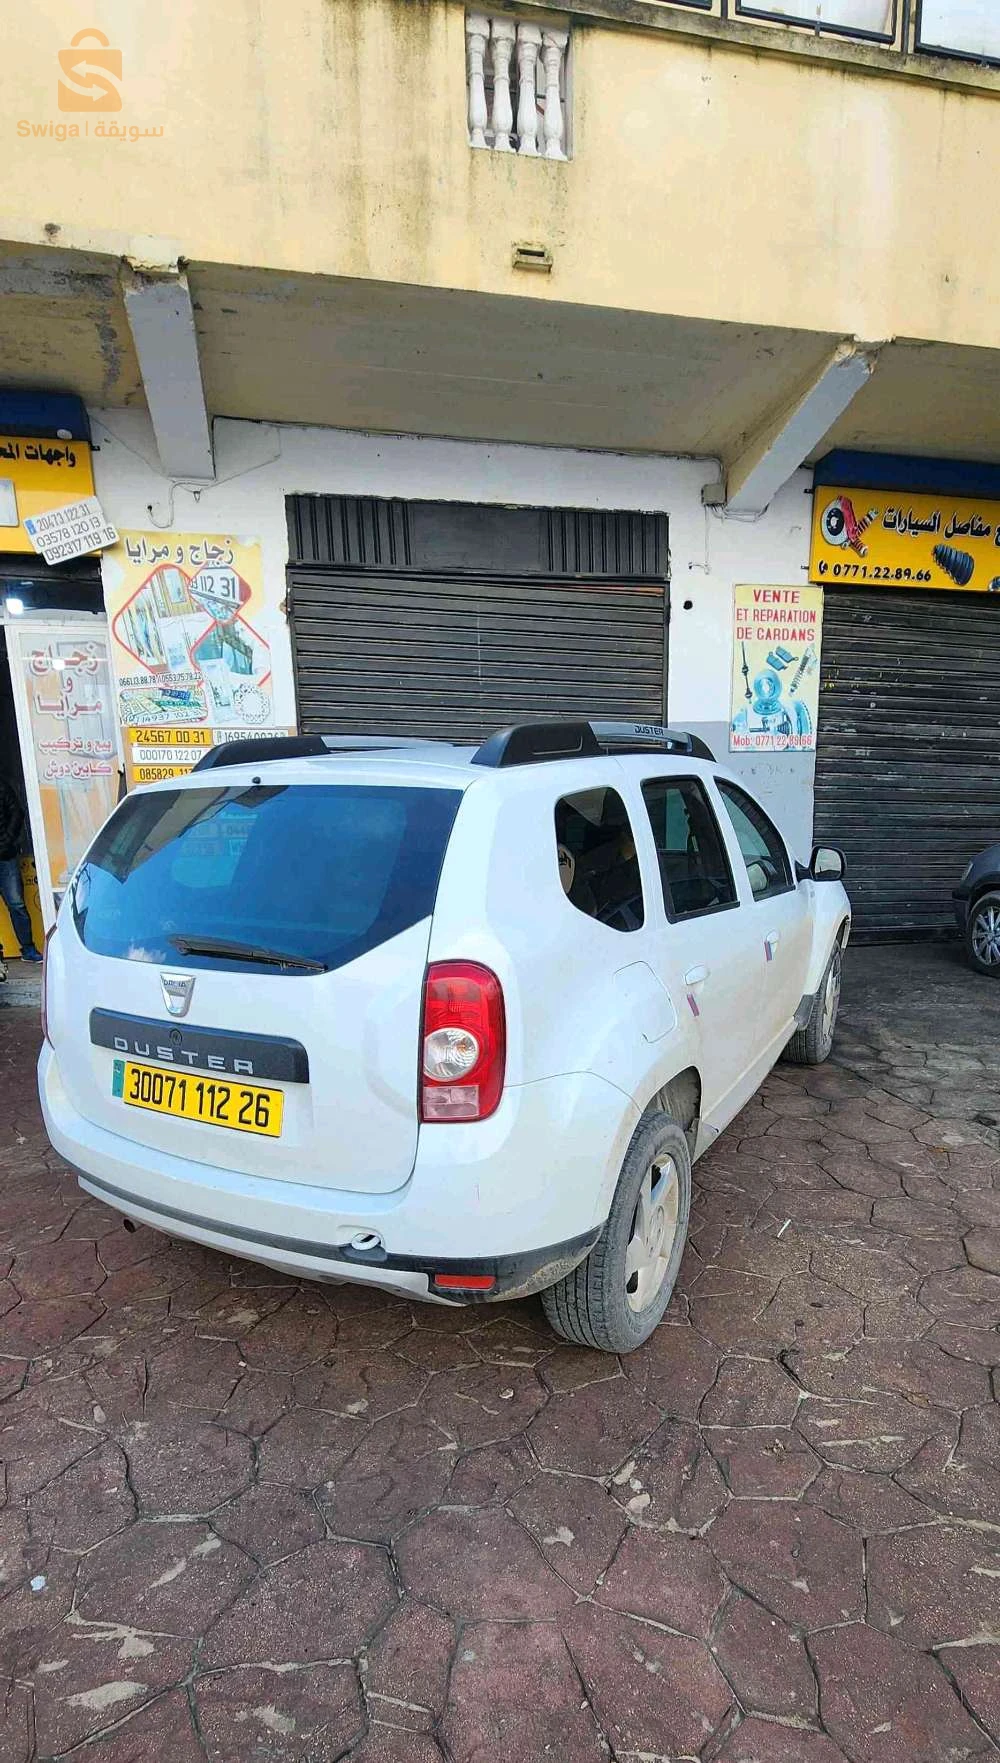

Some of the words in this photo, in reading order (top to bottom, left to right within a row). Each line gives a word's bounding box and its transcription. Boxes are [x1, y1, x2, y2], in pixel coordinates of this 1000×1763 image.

[24, 443, 76, 467] واجهات
[36, 512, 65, 531] 20473
[63, 506, 79, 521] 122
[79, 503, 92, 515] 31
[882, 506, 941, 536] السيارات
[944, 511, 990, 538] مفاصل
[36, 528, 71, 547] 03578
[71, 520, 90, 534] 120
[89, 516, 101, 529] 13
[44, 539, 82, 561] 092317
[83, 531, 102, 548] 119
[102, 527, 116, 541] 16
[126, 537, 169, 563] مرايا
[176, 546, 184, 563] و
[189, 539, 234, 565] زجاج
[833, 563, 932, 582] 0771.22.89.66
[200, 575, 215, 593] 112
[219, 577, 236, 599] 31
[752, 589, 801, 604] VENTE
[736, 608, 749, 621] ET
[752, 609, 817, 623] REPARATION
[736, 627, 753, 641] DE
[756, 627, 816, 642] CARDANS
[31, 645, 98, 673] زجاج
[37, 694, 103, 717] مرايا
[136, 730, 172, 744] 24567
[176, 731, 191, 744] 00
[193, 731, 206, 744] 31
[733, 735, 753, 746] Mob:
[755, 735, 774, 746] 0771
[776, 735, 787, 746] 22
[139, 749, 173, 761] 000170
[72, 761, 112, 777] كابين
[139, 767, 174, 781] 085829
[114, 1036, 254, 1075] DUSTER
[129, 1068, 187, 1112] 30071
[195, 1081, 231, 1121] 112
[238, 1090, 271, 1128] 26
